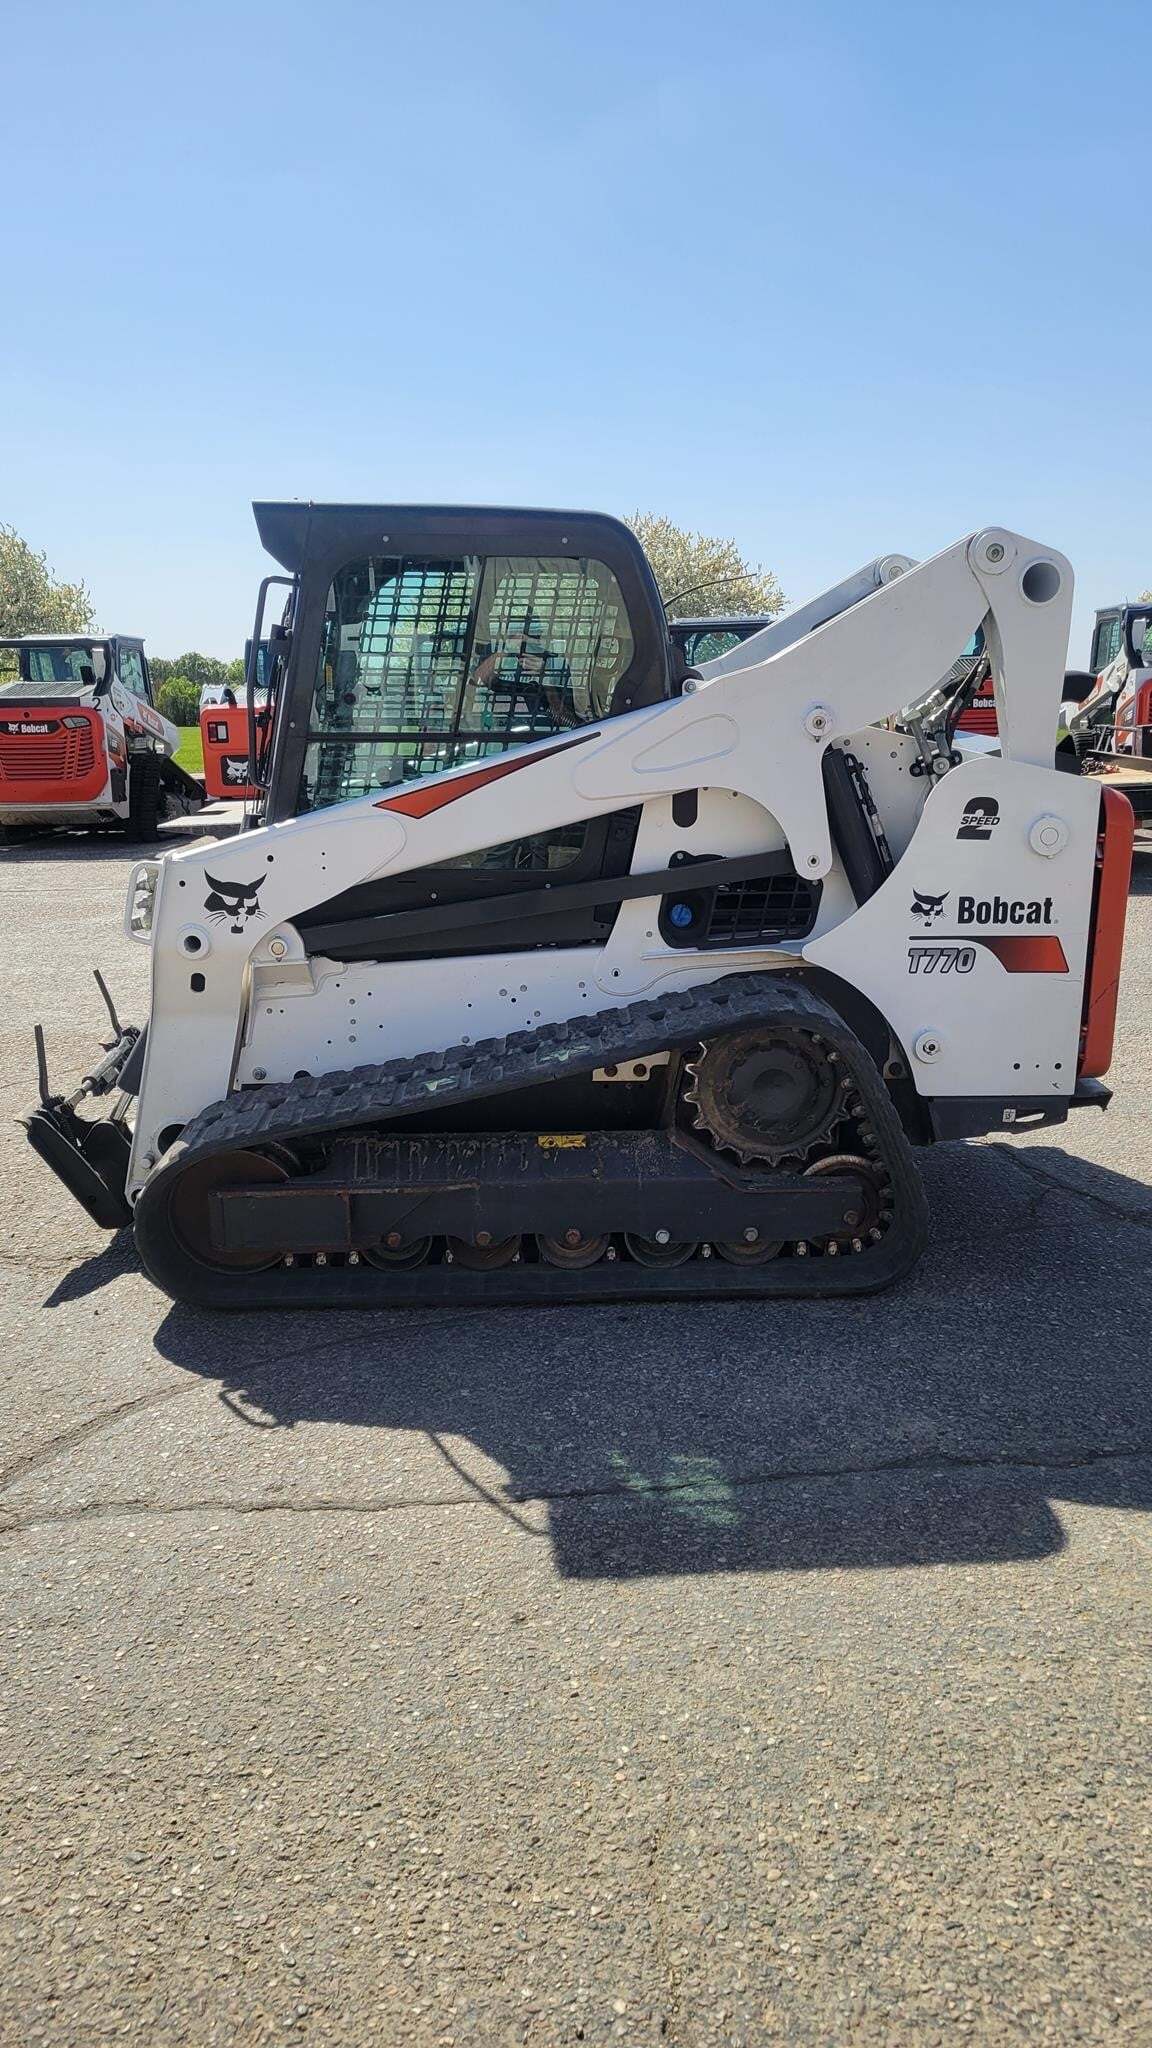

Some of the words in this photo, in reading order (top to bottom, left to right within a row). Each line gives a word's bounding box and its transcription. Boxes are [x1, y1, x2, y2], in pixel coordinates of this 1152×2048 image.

[21, 724, 49, 733] Bobcat
[956, 796, 999, 840] 2
[960, 816, 1000, 825] SPEED
[957, 896, 1053, 924] Bobcat
[908, 947, 977, 973] T770
